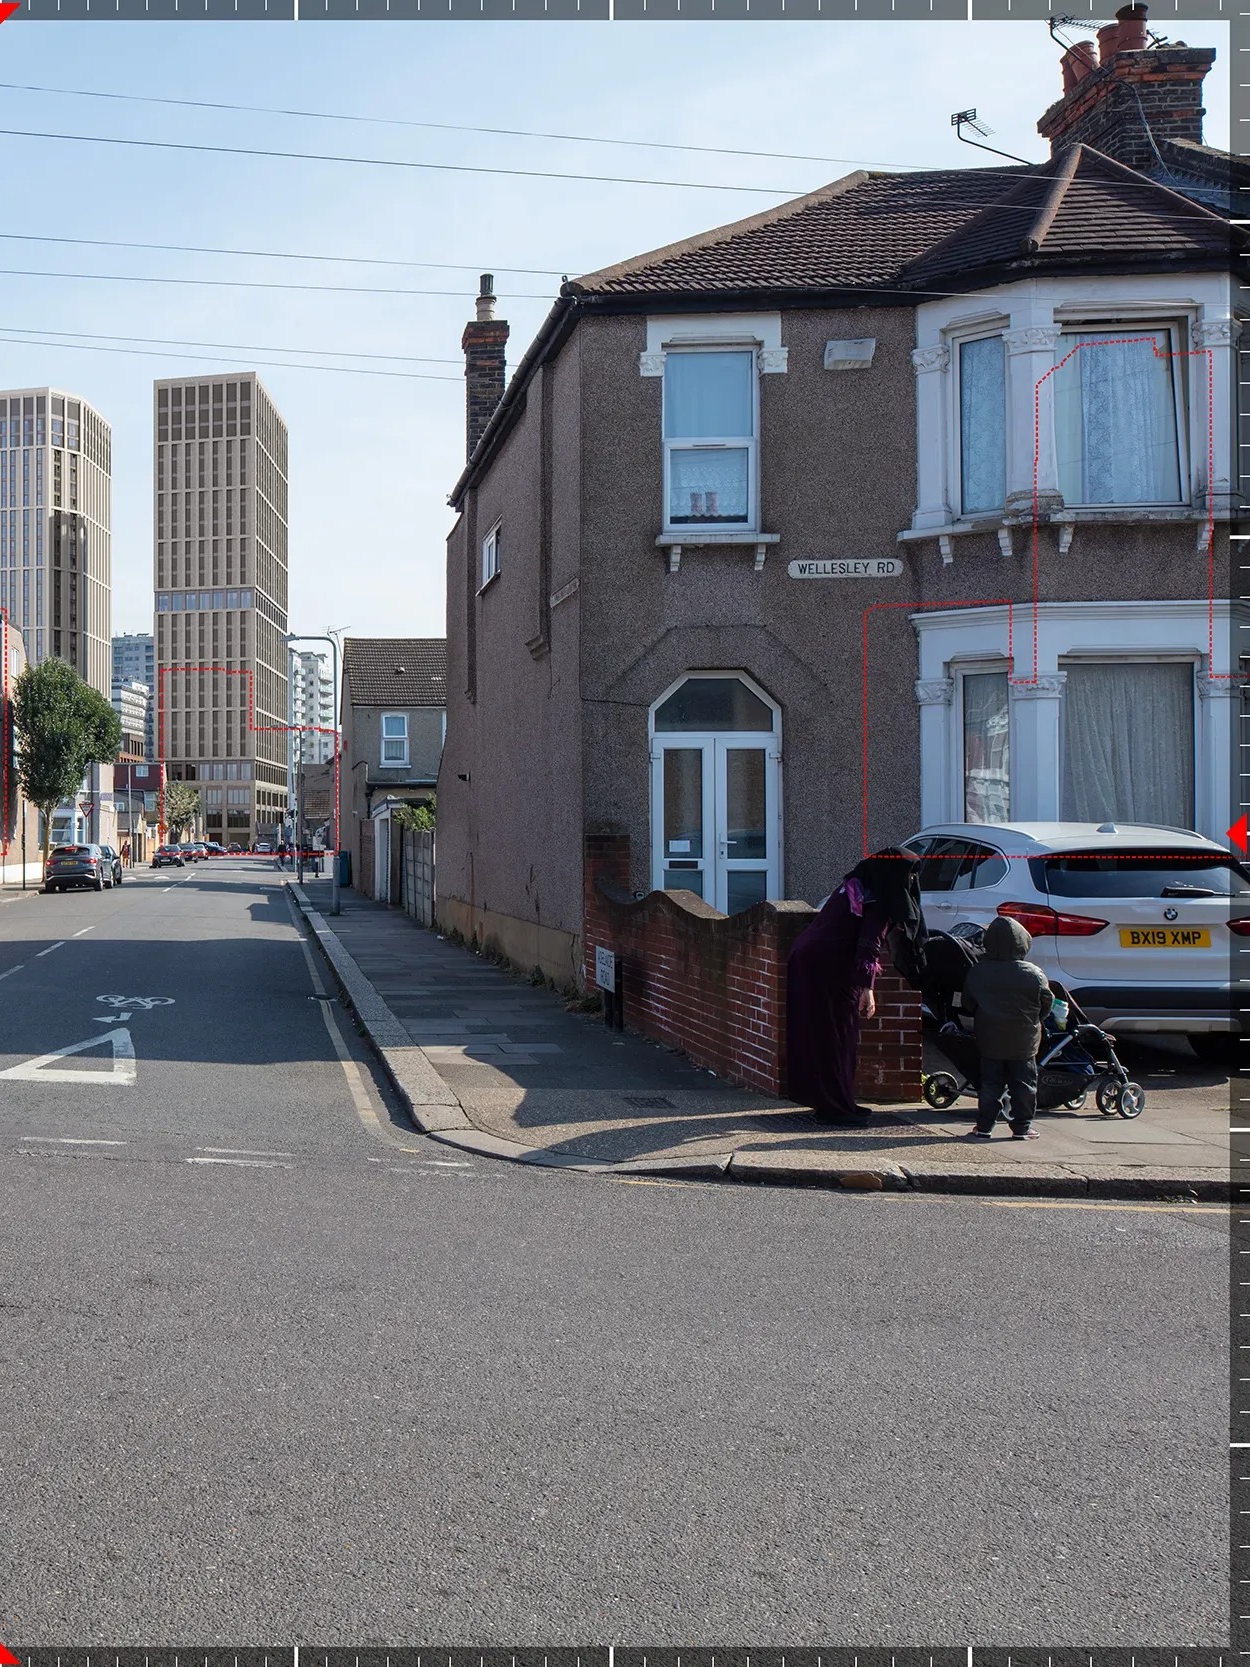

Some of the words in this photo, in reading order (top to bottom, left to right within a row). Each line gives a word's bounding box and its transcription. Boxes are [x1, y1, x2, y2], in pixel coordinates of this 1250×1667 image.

[797, 561, 870, 575] WELLESLEY
[877, 561, 895, 574] RD
[1130, 931, 1166, 945] BX19
[1170, 931, 1202, 945] XMP
